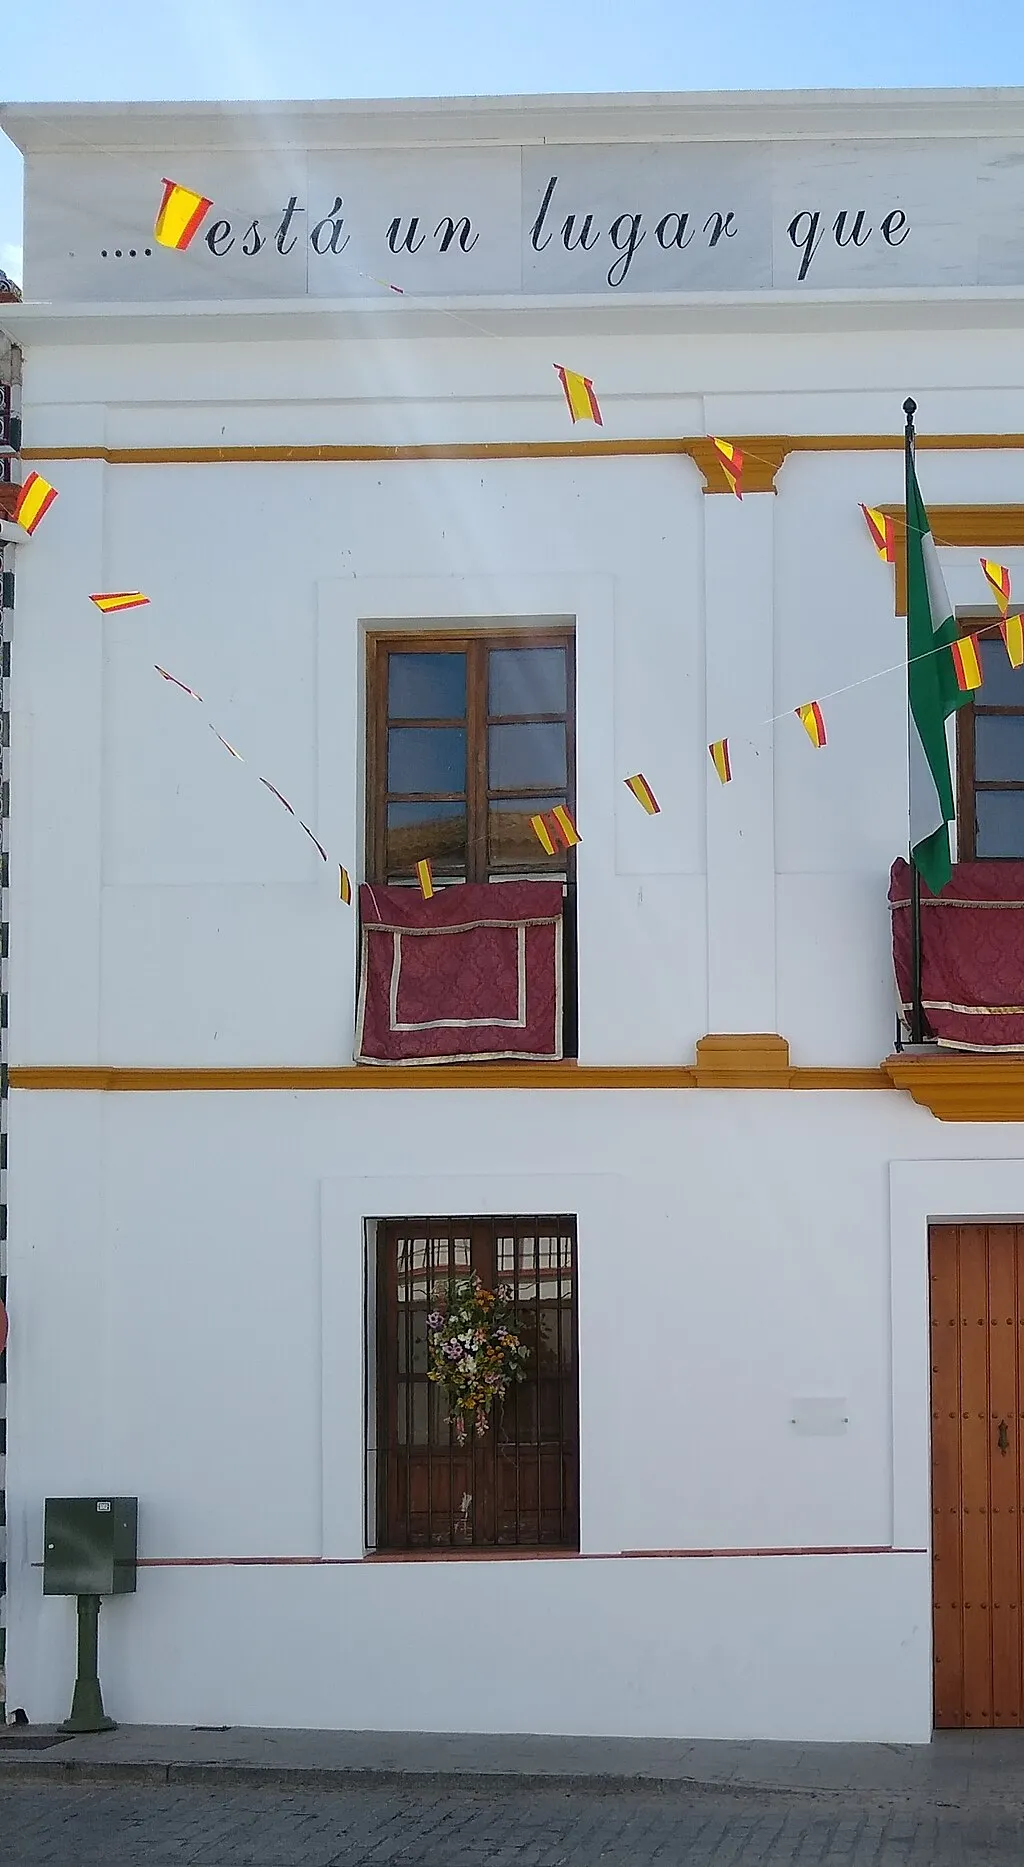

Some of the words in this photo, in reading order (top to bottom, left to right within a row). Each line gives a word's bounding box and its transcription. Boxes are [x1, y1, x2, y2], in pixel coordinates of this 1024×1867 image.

[205, 196, 350, 256] está
[386, 216, 480, 254] un
[529, 176, 738, 287] lugar
[786, 209, 911, 281] que
